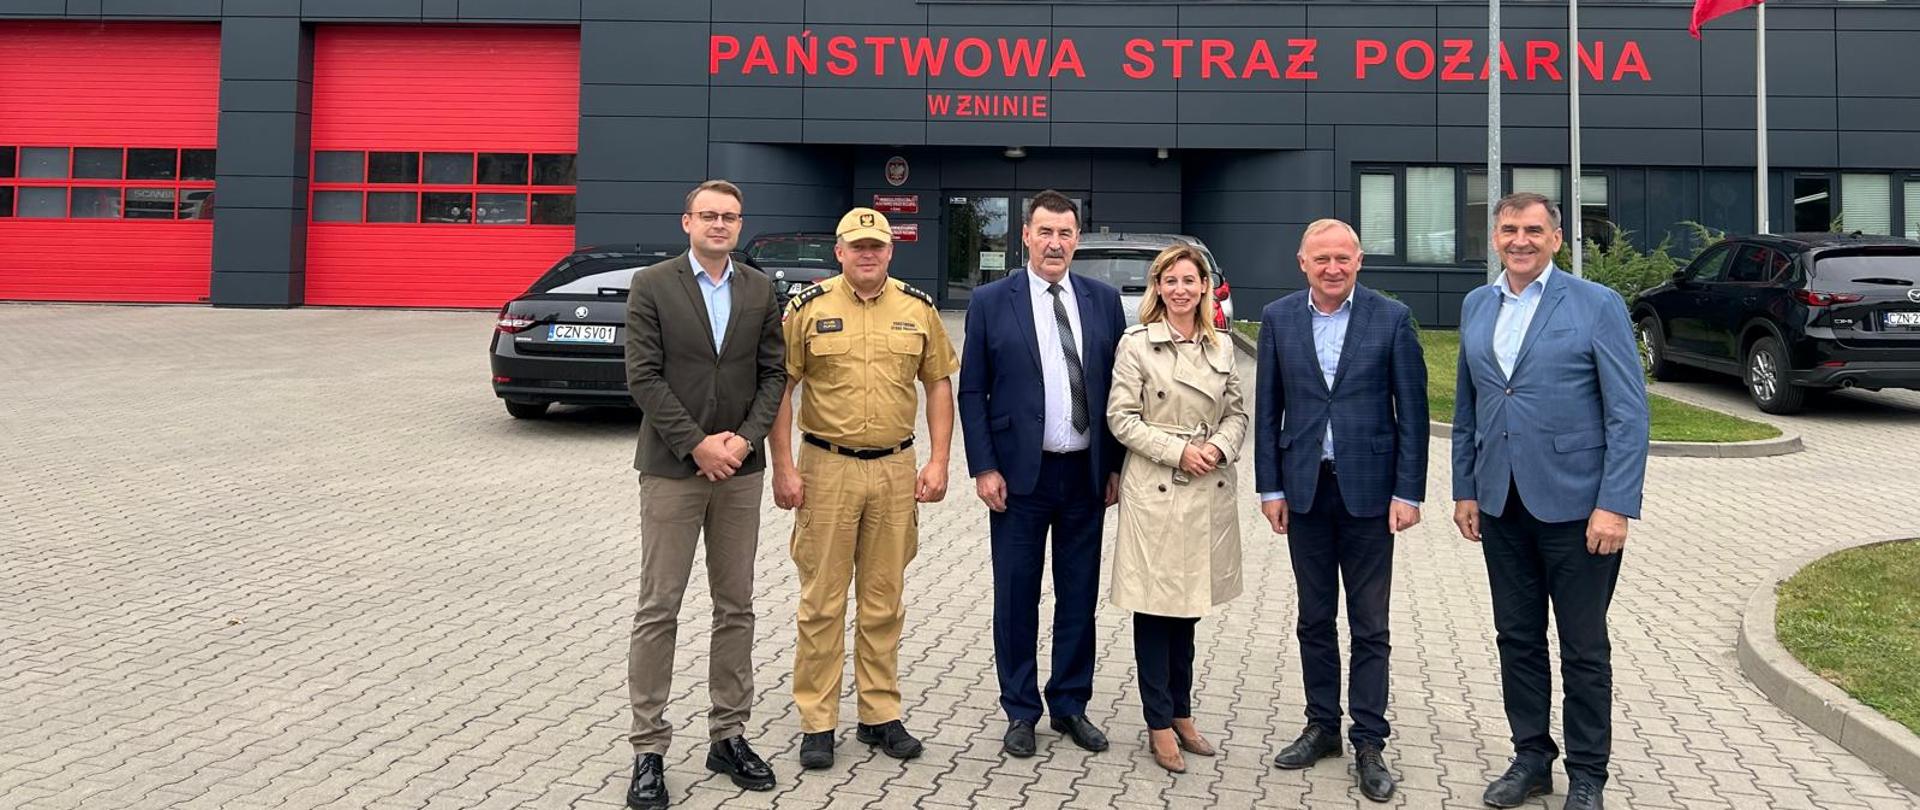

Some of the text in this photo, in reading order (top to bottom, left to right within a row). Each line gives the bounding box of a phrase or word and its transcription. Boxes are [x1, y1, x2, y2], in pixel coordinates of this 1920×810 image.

[709, 31, 1085, 79] PAŃSTWOWA
[927, 94, 951, 117] W
[555, 325, 612, 340] CZN SV01
